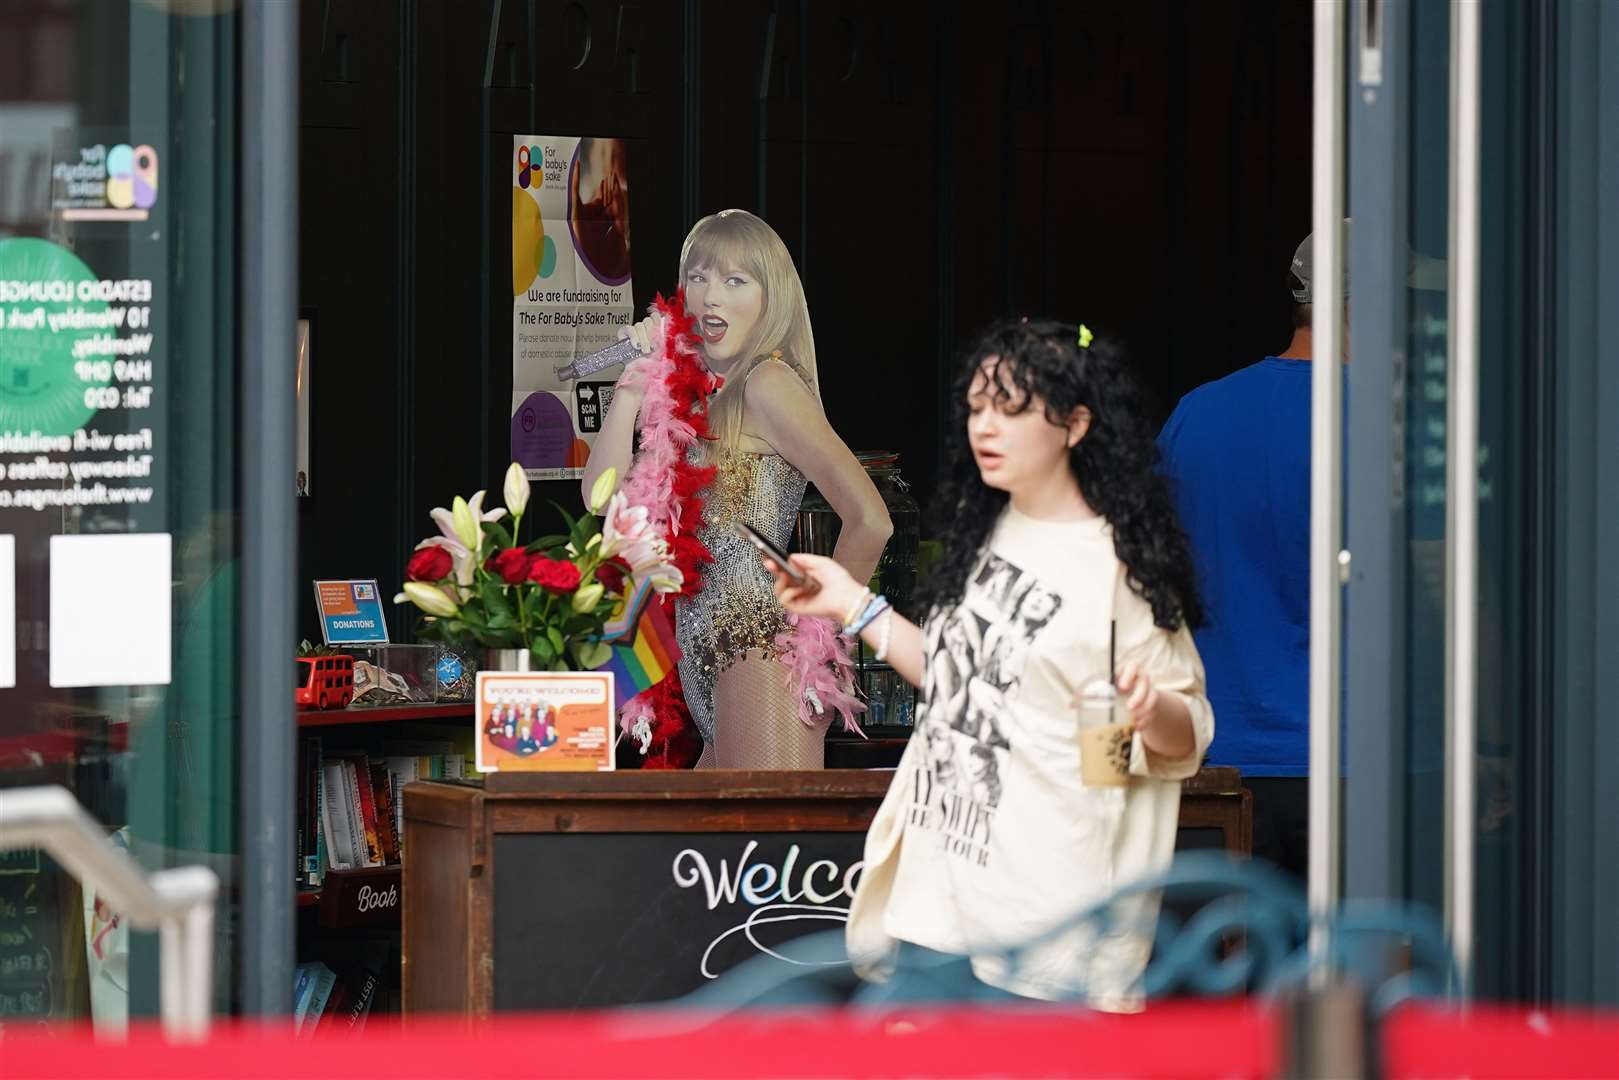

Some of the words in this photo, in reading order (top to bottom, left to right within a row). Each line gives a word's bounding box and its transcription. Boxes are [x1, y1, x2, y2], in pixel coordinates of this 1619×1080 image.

[544, 146, 556, 157] For
[544, 159, 568, 172] baby's
[544, 172, 561, 182] sake
[527, 289, 544, 302] We
[546, 291, 561, 302] are
[562, 288, 610, 305] fundraising
[610, 289, 622, 302] for
[519, 312, 536, 325] The
[538, 312, 553, 325] For
[554, 312, 584, 327] Baby's
[584, 312, 606, 325] Sake
[606, 312, 630, 325] Trust!
[580, 404, 597, 415] SCAN
[584, 416, 596, 428] ME
[332, 619, 375, 629] DONATIONS
[943, 834, 990, 868] TOUR
[357, 884, 398, 912] Book
[361, 975, 378, 1001] LOST
